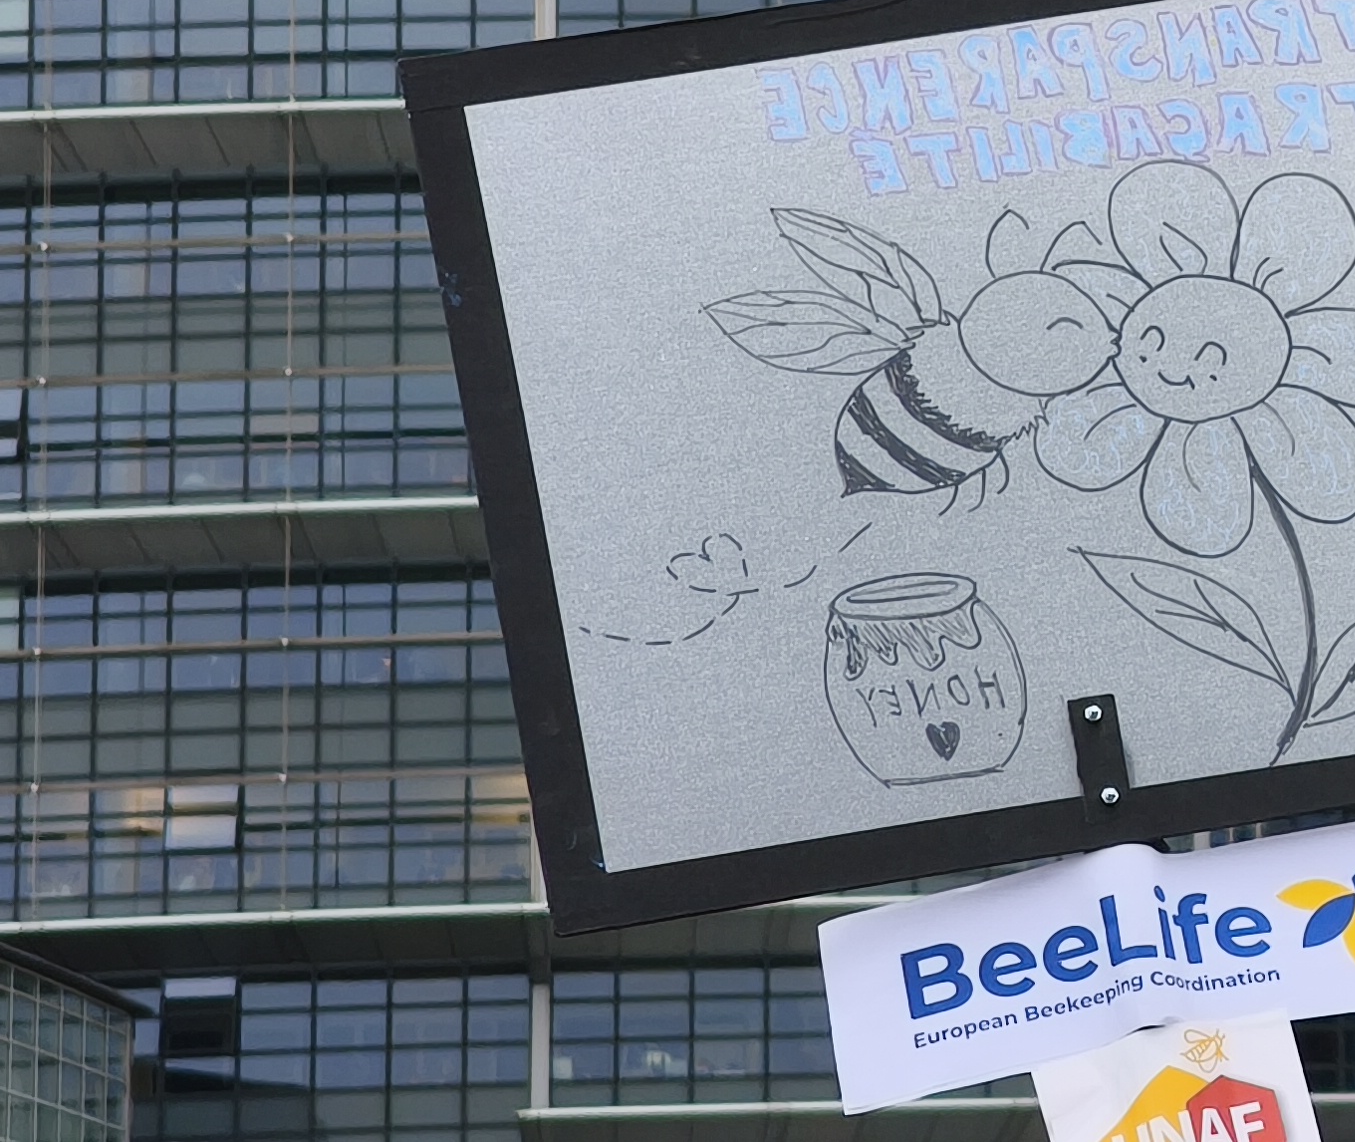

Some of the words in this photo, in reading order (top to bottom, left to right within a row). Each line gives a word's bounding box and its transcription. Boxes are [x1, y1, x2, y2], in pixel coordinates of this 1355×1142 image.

[899, 885, 1272, 1021] BeeLife
[913, 1010, 1018, 1050] European
[1024, 973, 1144, 1023] Beekeeping
[1150, 966, 1281, 994] Coordination
[1111, 1101, 1264, 1142] NAF
